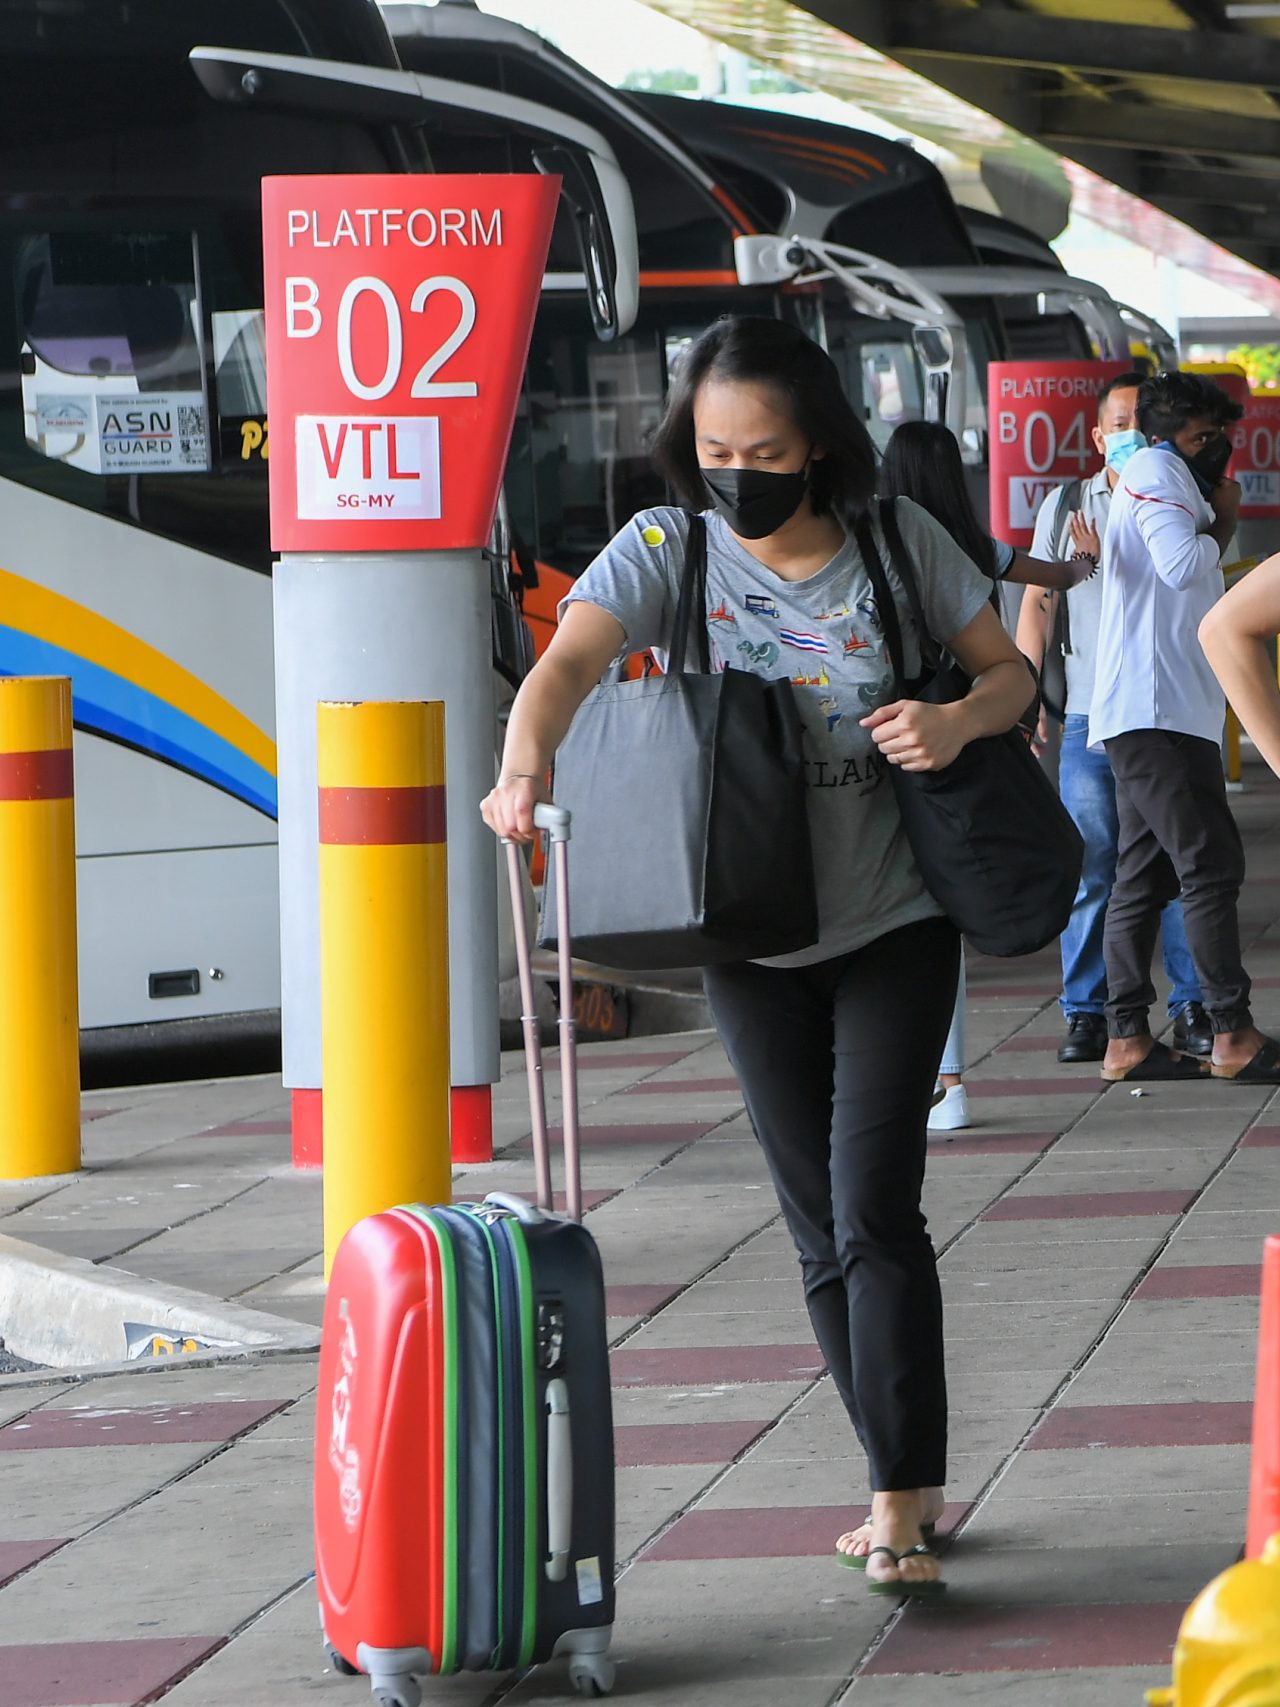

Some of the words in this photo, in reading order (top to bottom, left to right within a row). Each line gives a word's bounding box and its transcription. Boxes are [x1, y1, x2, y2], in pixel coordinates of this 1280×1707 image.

[287, 207, 503, 248] PLATFORM
[1000, 376, 1105, 399] PLATFORM
[102, 410, 172, 434] ASN
[103, 438, 173, 455] GUARD
[315, 422, 422, 481] VTL
[1022, 480, 1060, 510] VT
[1243, 474, 1275, 494] VTL
[336, 493, 397, 509] SG-MY
